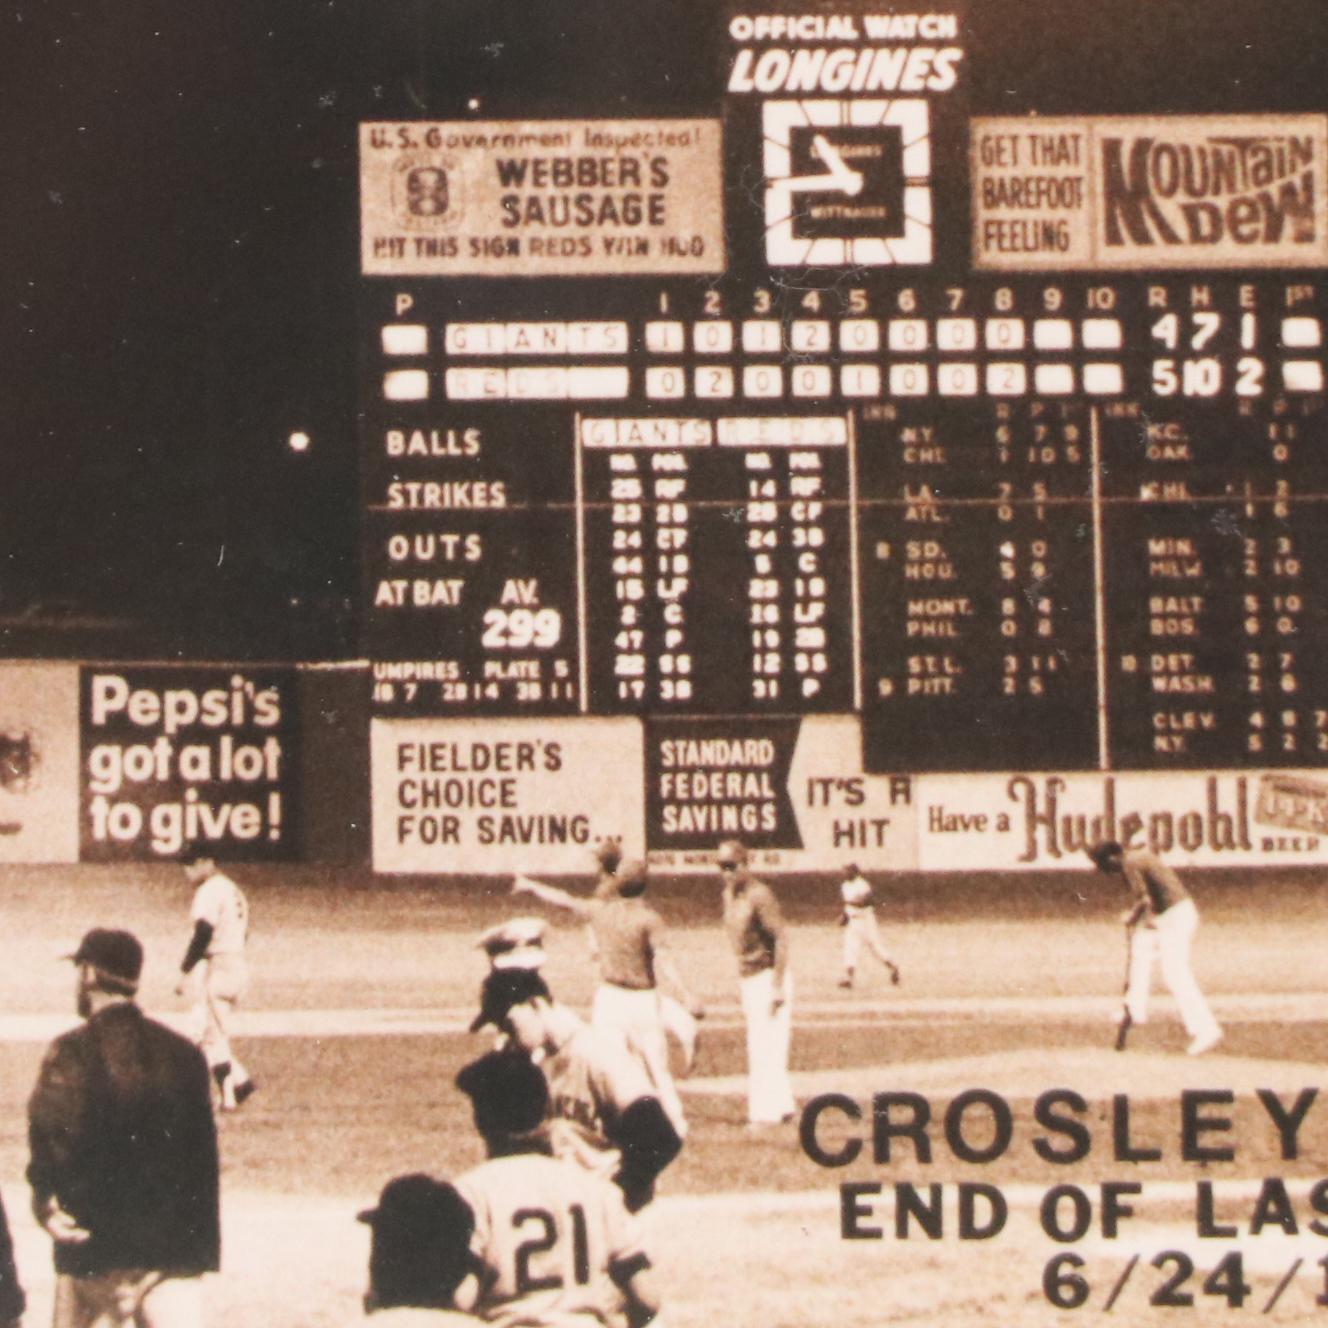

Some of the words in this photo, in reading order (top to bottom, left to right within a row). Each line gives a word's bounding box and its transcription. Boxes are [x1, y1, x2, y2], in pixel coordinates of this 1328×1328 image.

[728, 16, 859, 41] OFFICIAL
[866, 14, 959, 38] WATCH
[727, 48, 964, 93] LONGINES
[980, 134, 1020, 169] GET
[1029, 133, 1081, 167] THAT
[496, 155, 670, 189] WEBBER'S
[982, 175, 1084, 210] BAREFOOT
[501, 194, 666, 228] SAUSAGE
[415, 236, 458, 258] THIS
[470, 235, 520, 257] SIGN
[529, 235, 592, 257] REDS
[984, 219, 1069, 252] FEELING
[396, 293, 413, 315] P
[660, 292, 668, 314] 1
[704, 290, 721, 314] 2
[753, 289, 771, 314] 3
[801, 290, 820, 313] 4
[849, 289, 867, 313] 5
[898, 288, 915, 312] 6
[947, 288, 964, 311] 7
[995, 287, 1013, 311] 8
[1043, 287, 1062, 311] 9
[1087, 287, 1115, 310] 10
[1148, 286, 1167, 308] R
[1191, 285, 1210, 308] H
[1239, 284, 1256, 308] E
[452, 325, 620, 349] GIANTS
[706, 325, 720, 347] 0
[806, 325, 819, 346] 2
[854, 325, 868, 345] 0
[903, 324, 916, 345] 0
[951, 324, 965, 345] 0
[997, 323, 1010, 344] 0
[1151, 313, 1178, 350] 4
[1191, 312, 1220, 351] 7
[1241, 312, 1255, 350] 1
[663, 371, 676, 393] 0
[711, 372, 722, 393] 2
[756, 371, 769, 391] 0
[802, 371, 815, 391] 0
[903, 369, 916, 389] 0
[951, 369, 964, 389] 0
[1003, 368, 1015, 389] 2
[1152, 358, 1178, 396] 5
[1183, 357, 1222, 396] 10
[1235, 357, 1264, 396] 2
[386, 428, 481, 456] BALLS
[387, 482, 506, 508] STRIKES
[388, 535, 481, 561] OUTS
[375, 581, 408, 605] AT
[413, 581, 464, 605] BAT
[500, 579, 539, 604] AV.
[481, 608, 561, 648] 299
[373, 661, 460, 680] UMPIRES
[484, 660, 540, 678] PLATE
[91, 674, 281, 734] Pepsi's
[89, 736, 172, 793] got
[179, 745, 211, 780] a
[220, 734, 281, 780] lot
[397, 741, 563, 772] FIELDER'S
[660, 739, 774, 767] STANDARD
[397, 778, 518, 809] CHOICE
[661, 774, 774, 799] FEDERAL
[807, 777, 866, 807] IT'S
[889, 776, 911, 805] A
[90, 795, 142, 840] to
[397, 816, 461, 844] FOR
[661, 805, 775, 833] SAVINGS
[928, 804, 989, 833] Have
[995, 811, 1011, 832] a
[1007, 776, 1252, 862] Hudepohl
[832, 819, 890, 848] HIT
[510, 1202, 591, 1291] 21
